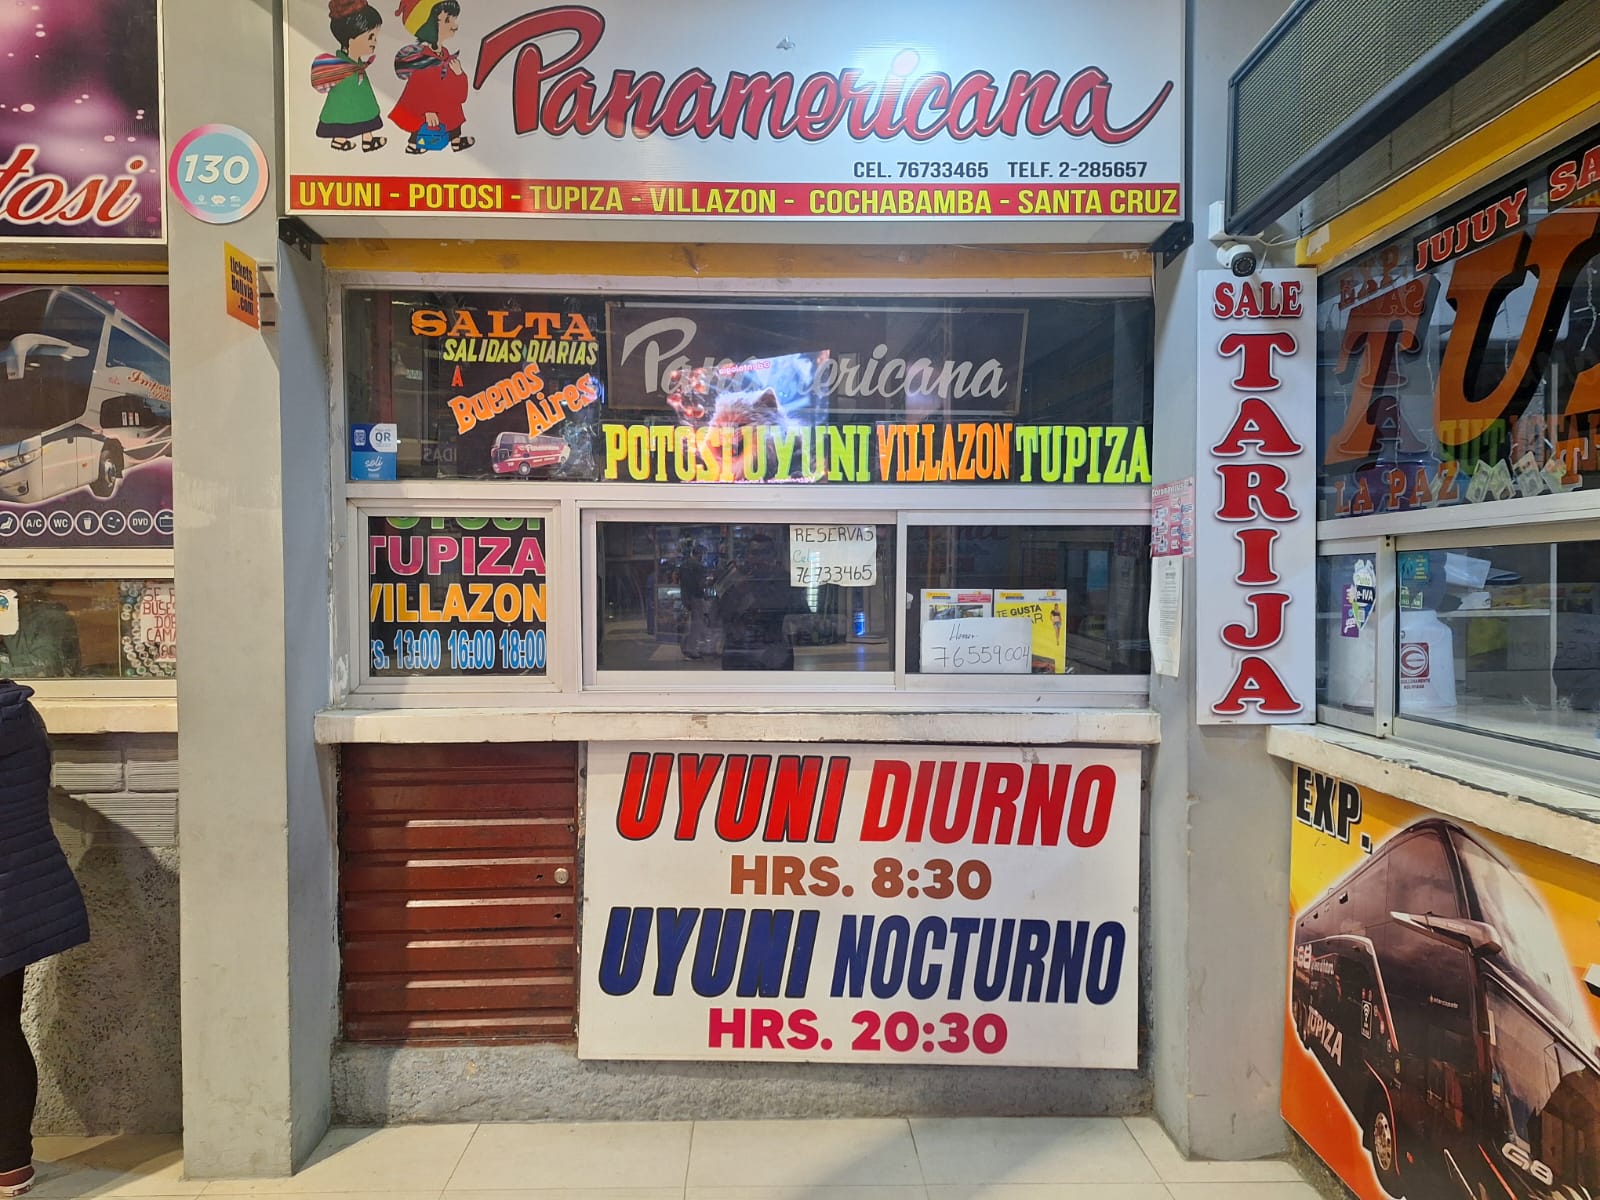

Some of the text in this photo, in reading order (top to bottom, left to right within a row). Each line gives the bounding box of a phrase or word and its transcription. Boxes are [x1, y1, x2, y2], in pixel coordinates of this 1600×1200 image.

[472, 4, 1174, 146] Panamericana
[184, 153, 250, 185] 130
[853, 161, 1148, 179] CEL. 76733465 TELF. 2-285657
[299, 181, 381, 208] UYUNI
[409, 182, 502, 210] POTOSI
[529, 185, 623, 212] TUPIZA
[650, 186, 776, 215] VILLAZON
[809, 189, 992, 215] COCHABAMBA
[1017, 189, 1102, 215] SANTA
[1109, 188, 1177, 215] CRUZ
[1415, 187, 1528, 272] JUJUY
[229, 255, 254, 284] tickets
[231, 274, 254, 301] Bolivia
[1213, 280, 1304, 320] SALE
[237, 295, 254, 316] .com
[411, 308, 597, 341] SALTA
[442, 338, 599, 366] SALIDAS DIARIAS
[451, 365, 464, 387] A
[448, 362, 545, 435] Buenos
[524, 372, 600, 440] Aires
[375, 432, 392, 442] QR
[601, 422, 1153, 483] POTOSI UYUNI VILLAZON TUPIZA
[1334, 476, 1375, 517] LA
[1386, 460, 1461, 511] PAZ
[26, 517, 43, 529] A/C
[53, 517, 69, 529] WC
[132, 517, 149, 527] DVD
[794, 526, 875, 543] RESERVAS
[1210, 330, 1305, 716] TARIJA
[795, 564, 873, 584] 76733465
[1009, 604, 1042, 616] GUSTA
[393, 629, 442, 670] 13:00
[447, 629, 496, 670] 16:00
[499, 629, 546, 670] 18:00
[930, 643, 1031, 669] 76559004
[616, 751, 1118, 848] UYUNI DIURNO
[1296, 765, 1374, 855] EXP.
[730, 854, 993, 900] HRS. 8:30
[598, 906, 1127, 1006] UYUNI NOCTURNO
[707, 1007, 1009, 1055] HRS. 20:30
